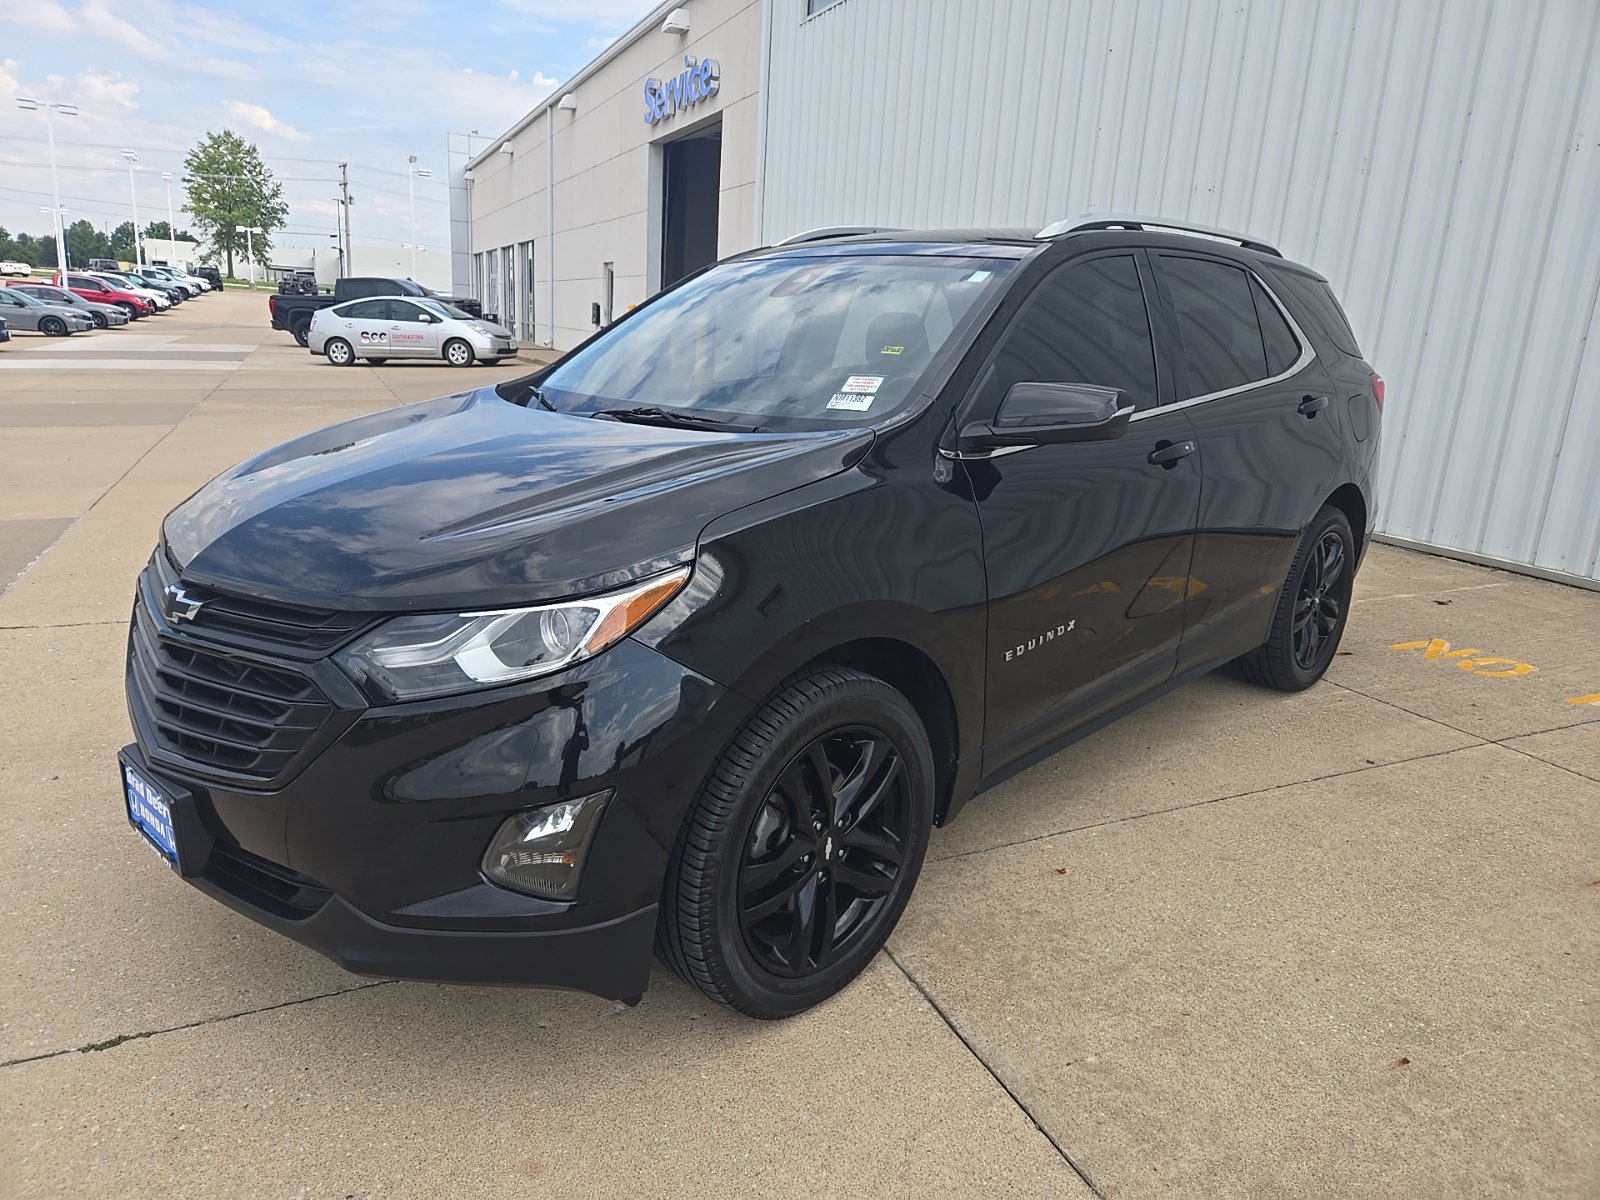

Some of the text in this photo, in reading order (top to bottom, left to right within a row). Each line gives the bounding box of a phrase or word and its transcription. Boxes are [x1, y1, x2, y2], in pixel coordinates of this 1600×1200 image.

[643, 54, 720, 126] Service
[360, 331, 387, 344] SCC
[1004, 619, 1076, 662] EQUINOX
[140, 803, 167, 839] HONDA
